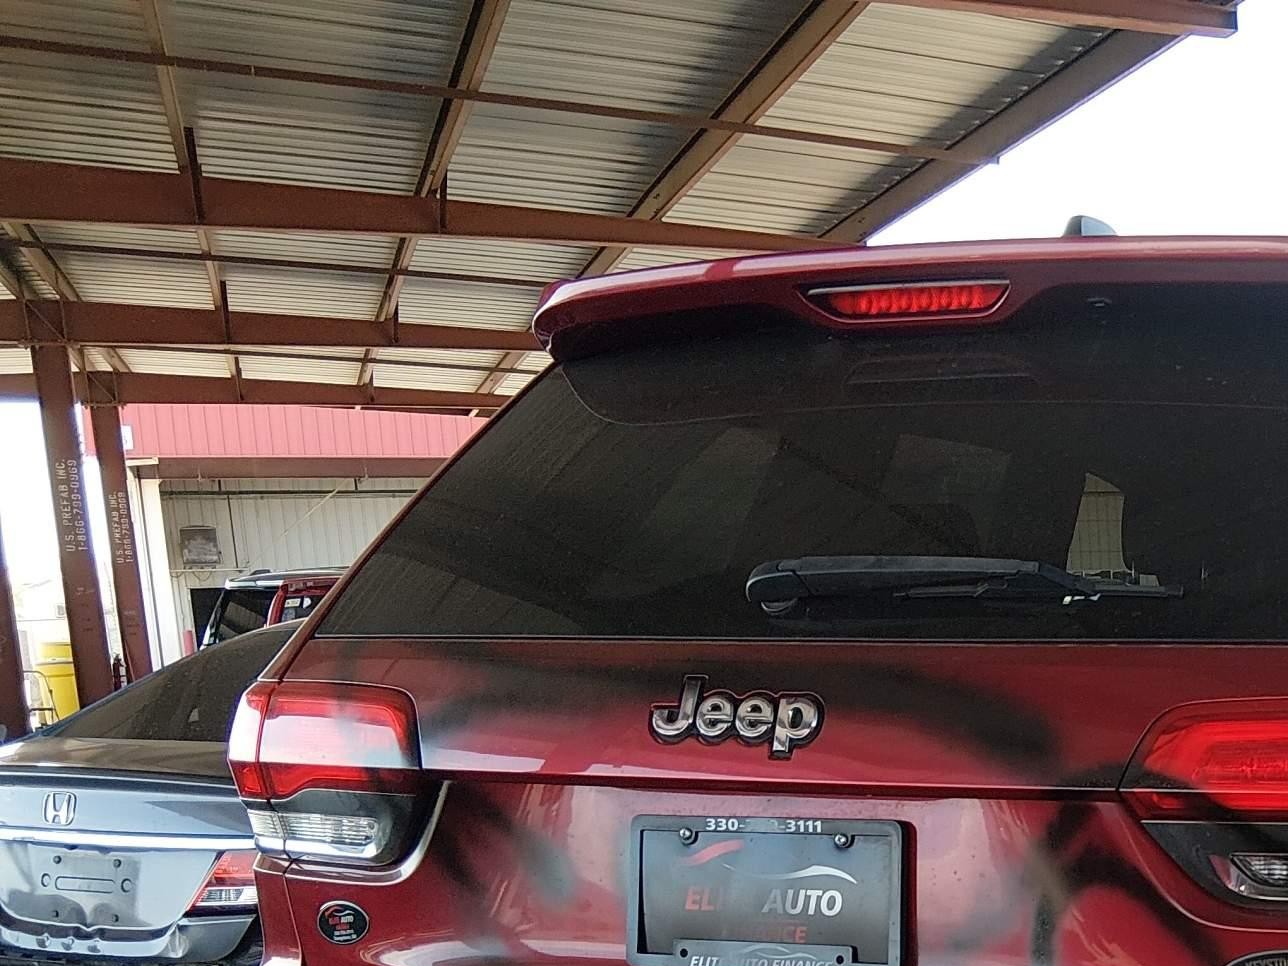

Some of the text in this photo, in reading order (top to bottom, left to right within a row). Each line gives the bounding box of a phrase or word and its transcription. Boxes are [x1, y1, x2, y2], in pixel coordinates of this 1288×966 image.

[56, 459, 66, 479] INC.
[58, 484, 73, 526] PREFAB
[650, 675, 823, 757] Jeep
[705, 818, 822, 833] 330--3111
[761, 888, 843, 917] AUTO
